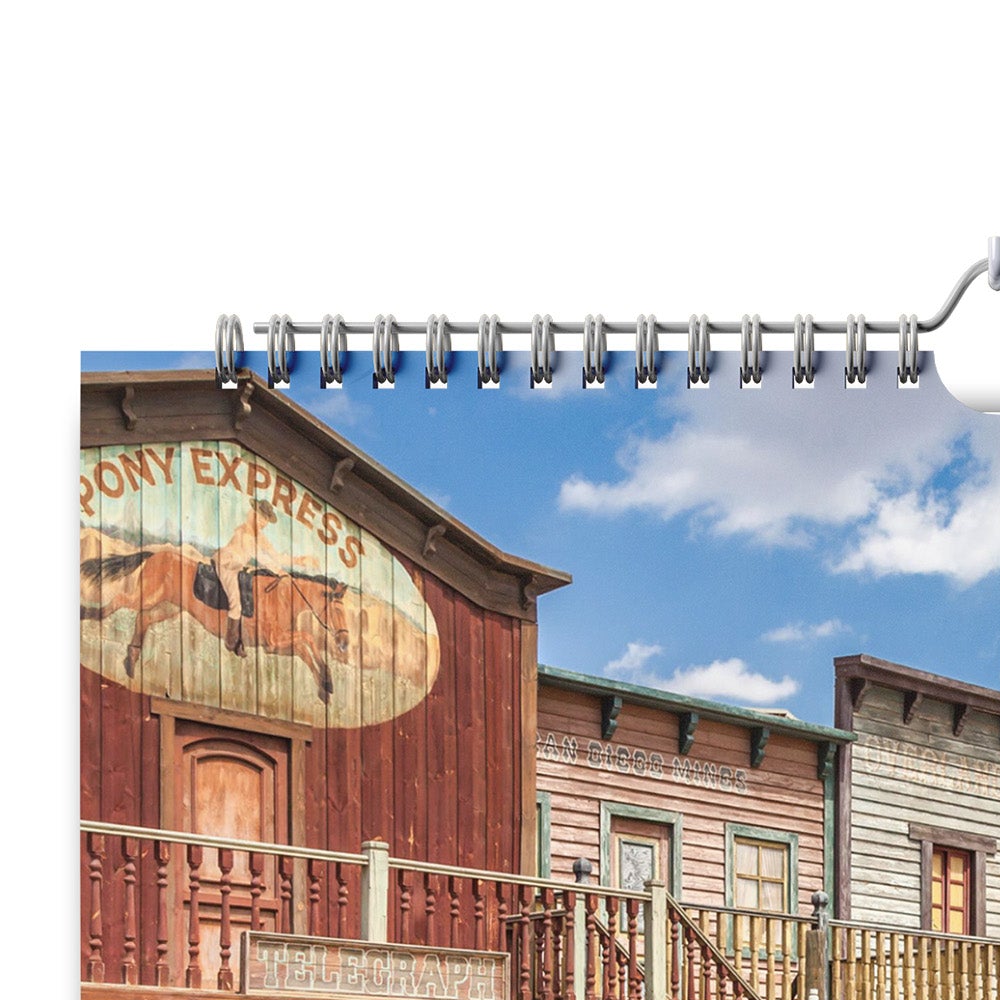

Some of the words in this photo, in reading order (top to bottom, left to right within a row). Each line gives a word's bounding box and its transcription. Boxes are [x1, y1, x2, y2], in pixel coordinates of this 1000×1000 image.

[80, 446, 175, 517] PONY
[190, 447, 365, 570] EXPRESS
[537, 730, 578, 765] AN
[587, 740, 665, 779] DIEGO
[672, 756, 748, 795] MINES
[256, 940, 496, 1000] TELEGRAPH
